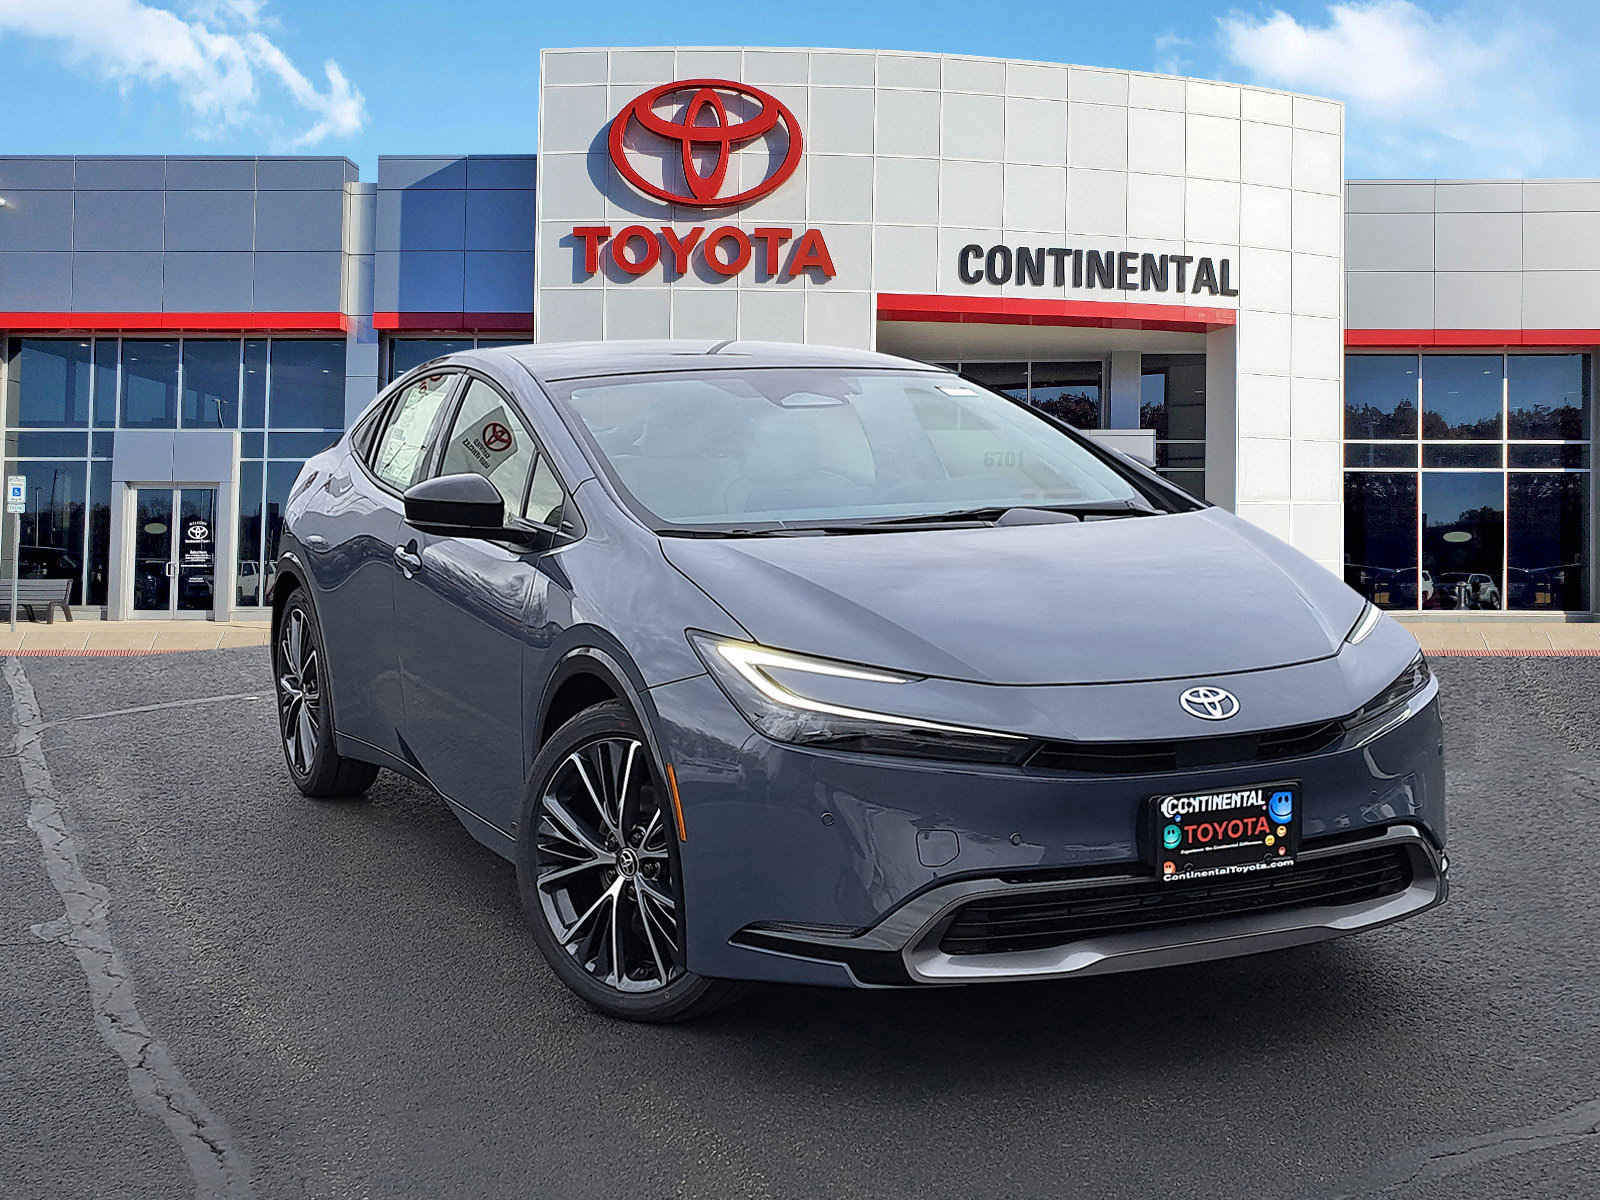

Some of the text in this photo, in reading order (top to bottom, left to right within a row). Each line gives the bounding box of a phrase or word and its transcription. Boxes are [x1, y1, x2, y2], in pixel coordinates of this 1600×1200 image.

[572, 225, 837, 277] TOYOTA
[959, 244, 1238, 296] CONTINENTAL
[983, 451, 1024, 468] 6701
[1162, 789, 1266, 817] CONTINENTAL
[1184, 816, 1271, 844] TOYOTA
[1163, 859, 1295, 882] ContinentalToyota.com
